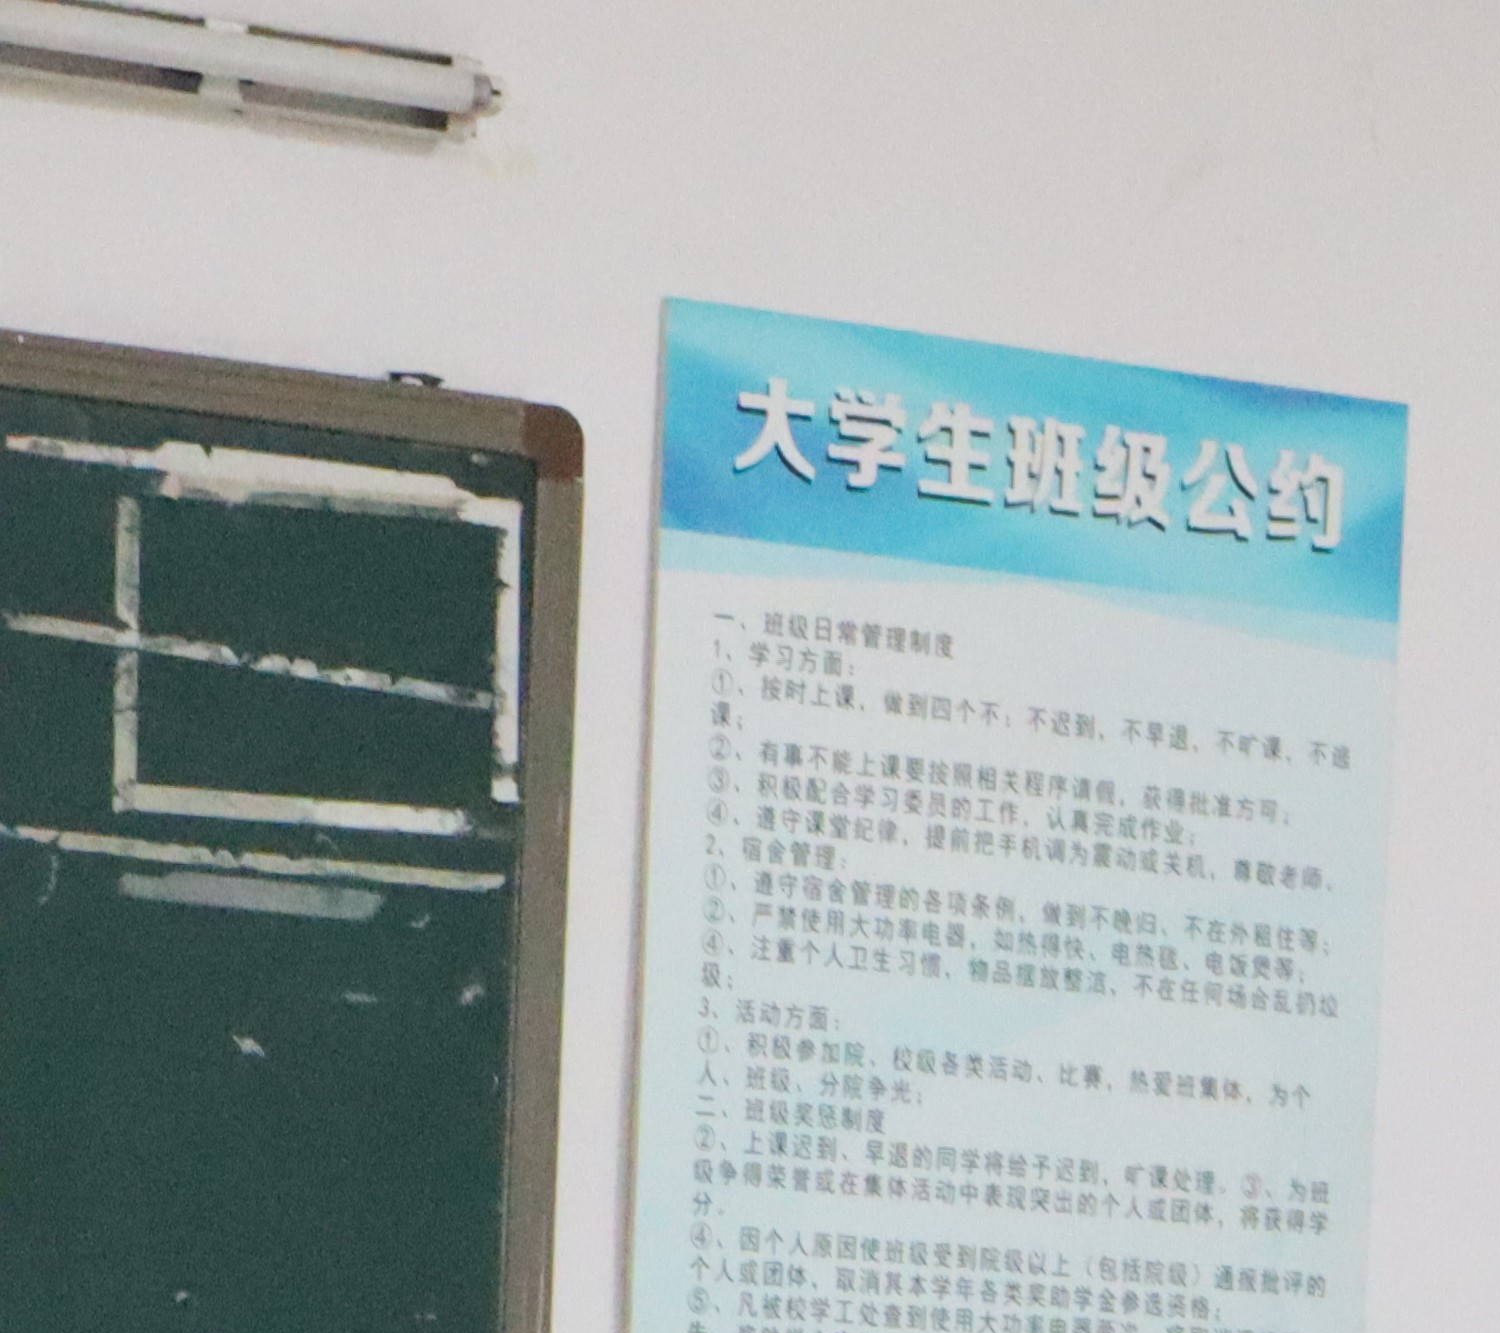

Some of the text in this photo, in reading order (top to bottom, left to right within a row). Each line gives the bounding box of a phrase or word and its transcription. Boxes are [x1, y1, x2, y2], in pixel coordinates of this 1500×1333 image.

[733, 378, 1345, 551] 大学生班级公约
[713, 604, 956, 660] 一、班级日常管理制度
